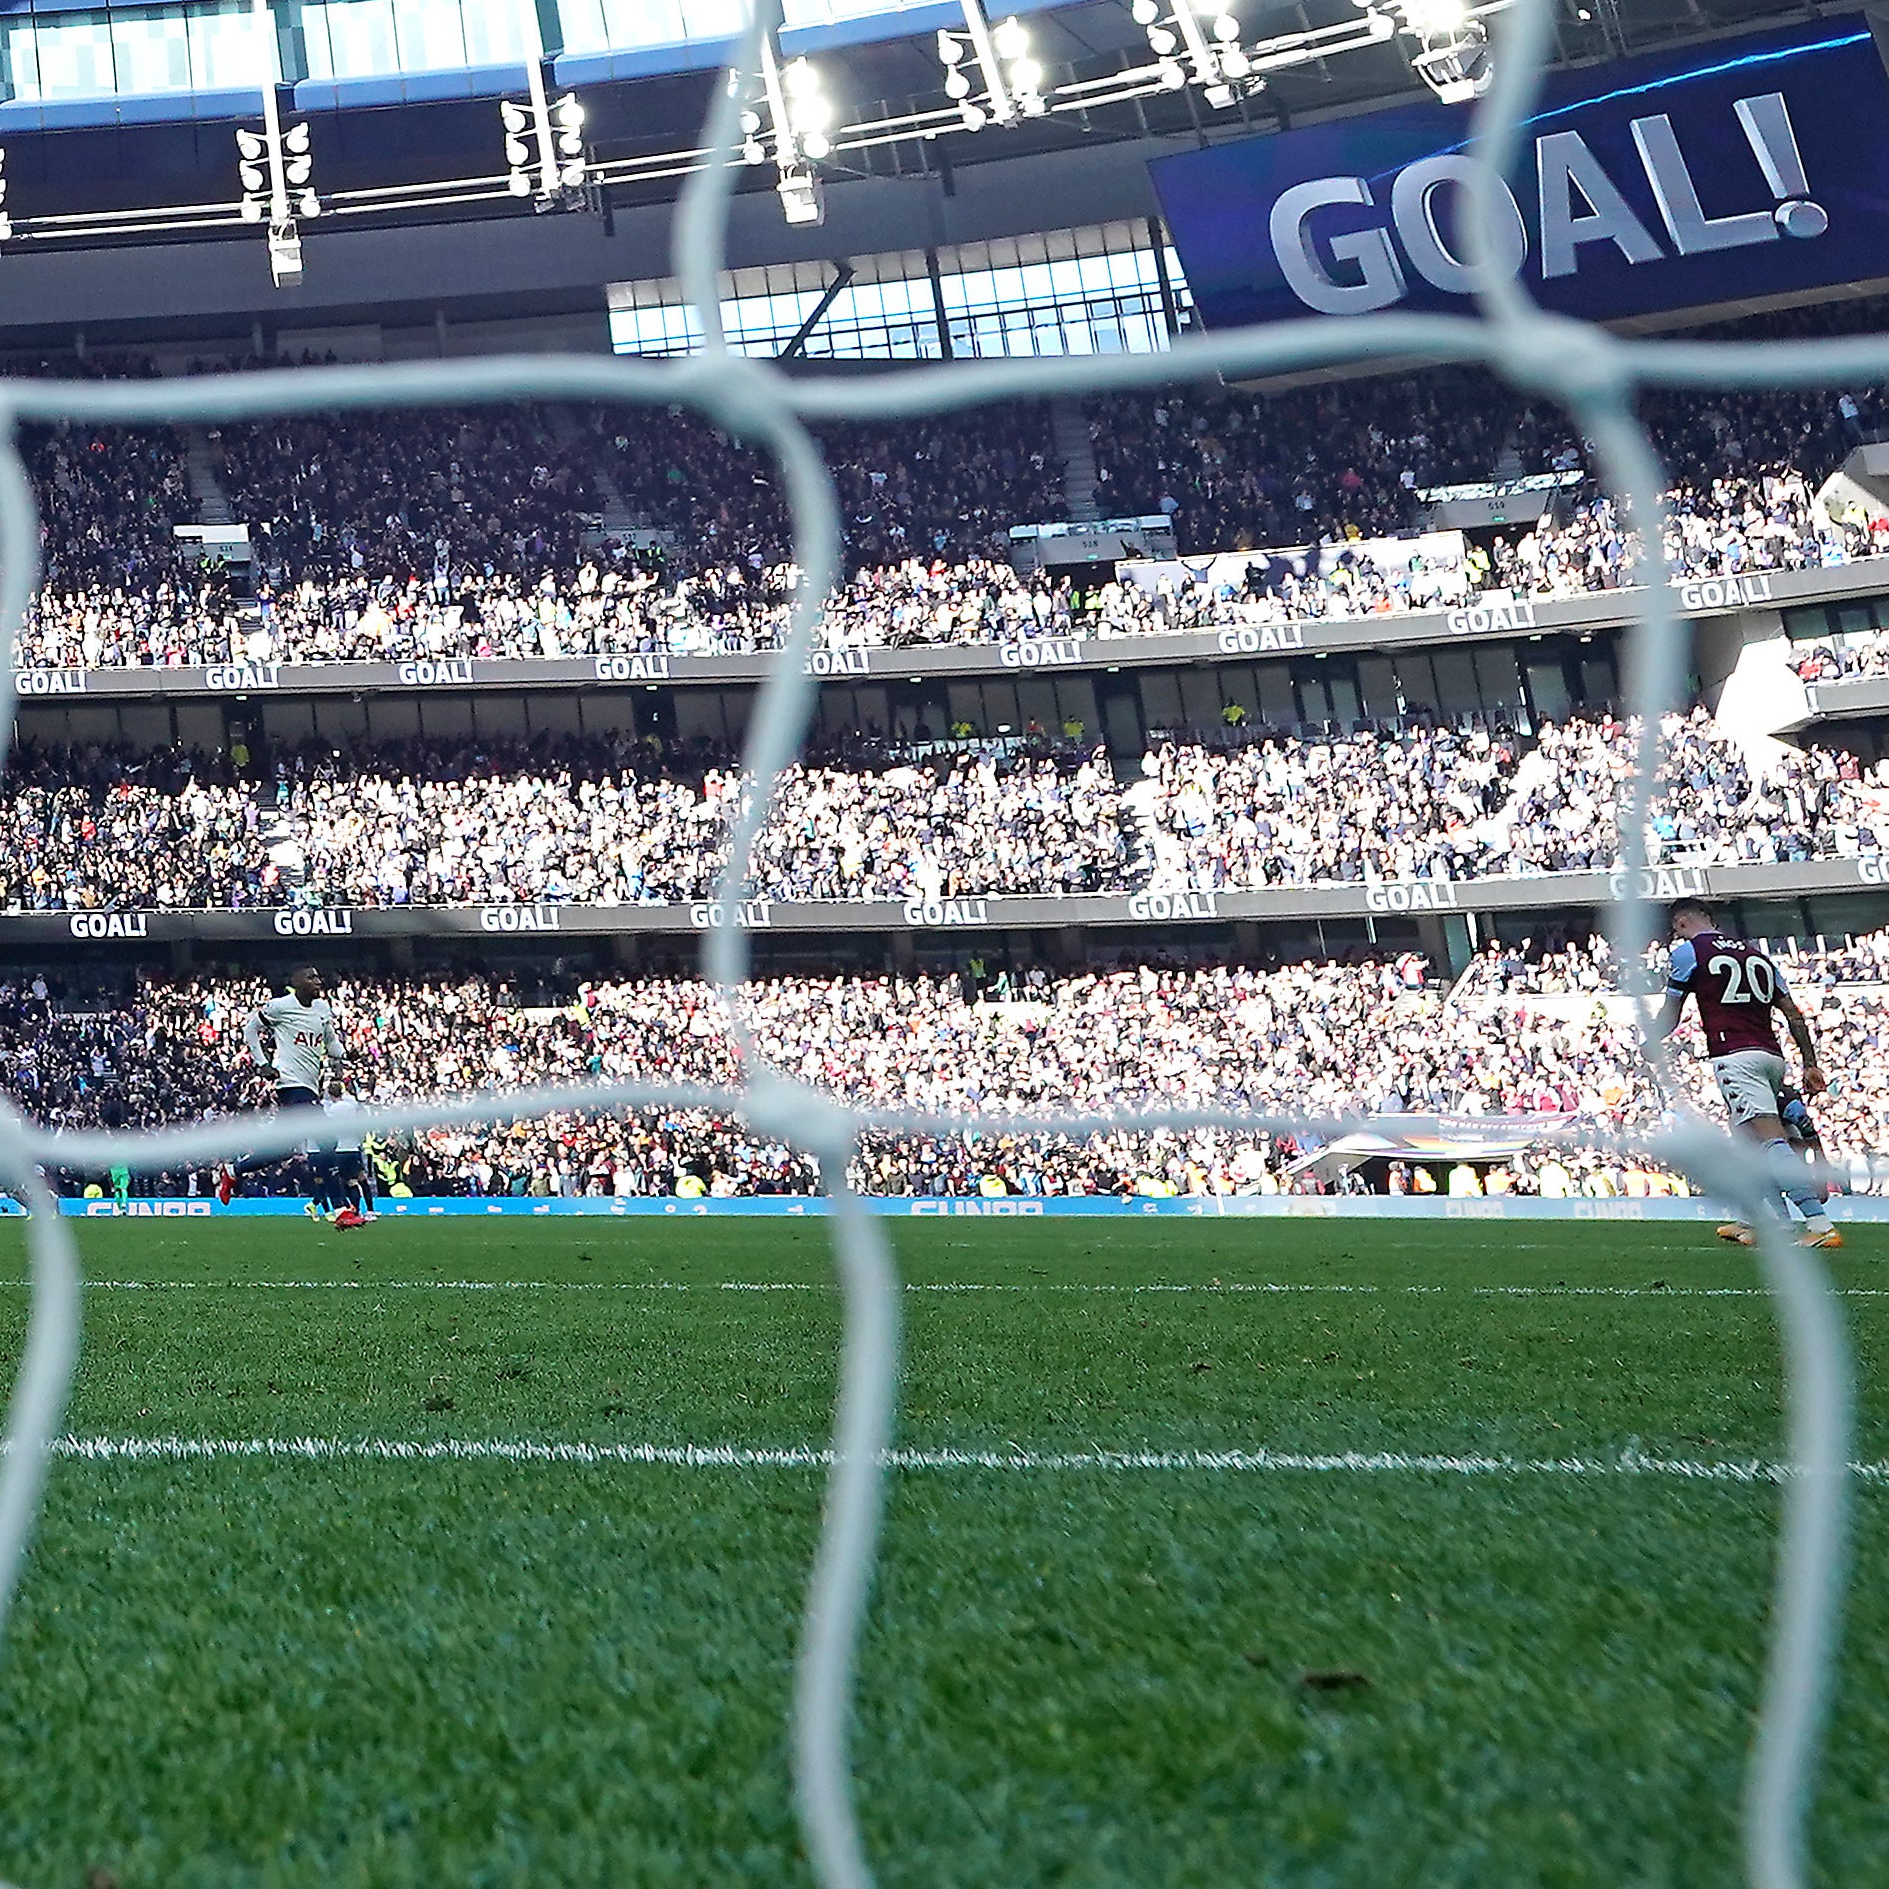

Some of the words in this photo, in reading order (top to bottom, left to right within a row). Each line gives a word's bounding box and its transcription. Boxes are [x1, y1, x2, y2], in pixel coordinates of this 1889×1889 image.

[1269, 92, 1830, 316] GOAL!
[1681, 576, 1771, 609] GOAL!
[1447, 605, 1536, 634] GOAL!
[1219, 626, 1303, 652] GOAL!
[596, 656, 669, 679] GOAL!
[1000, 642, 1081, 668] GOAL!
[16, 671, 86, 695] GOAL!
[206, 666, 278, 689] GOAL!
[400, 661, 473, 684] GOAL!
[1129, 892, 1217, 920] GOAL!
[1366, 883, 1456, 911] GOAL!
[71, 912, 146, 937] GOAL!
[274, 910, 352, 934] GOAL!
[481, 907, 558, 931] GOAL!
[904, 900, 987, 925] GOAL!
[1708, 955, 1775, 1004] 20
